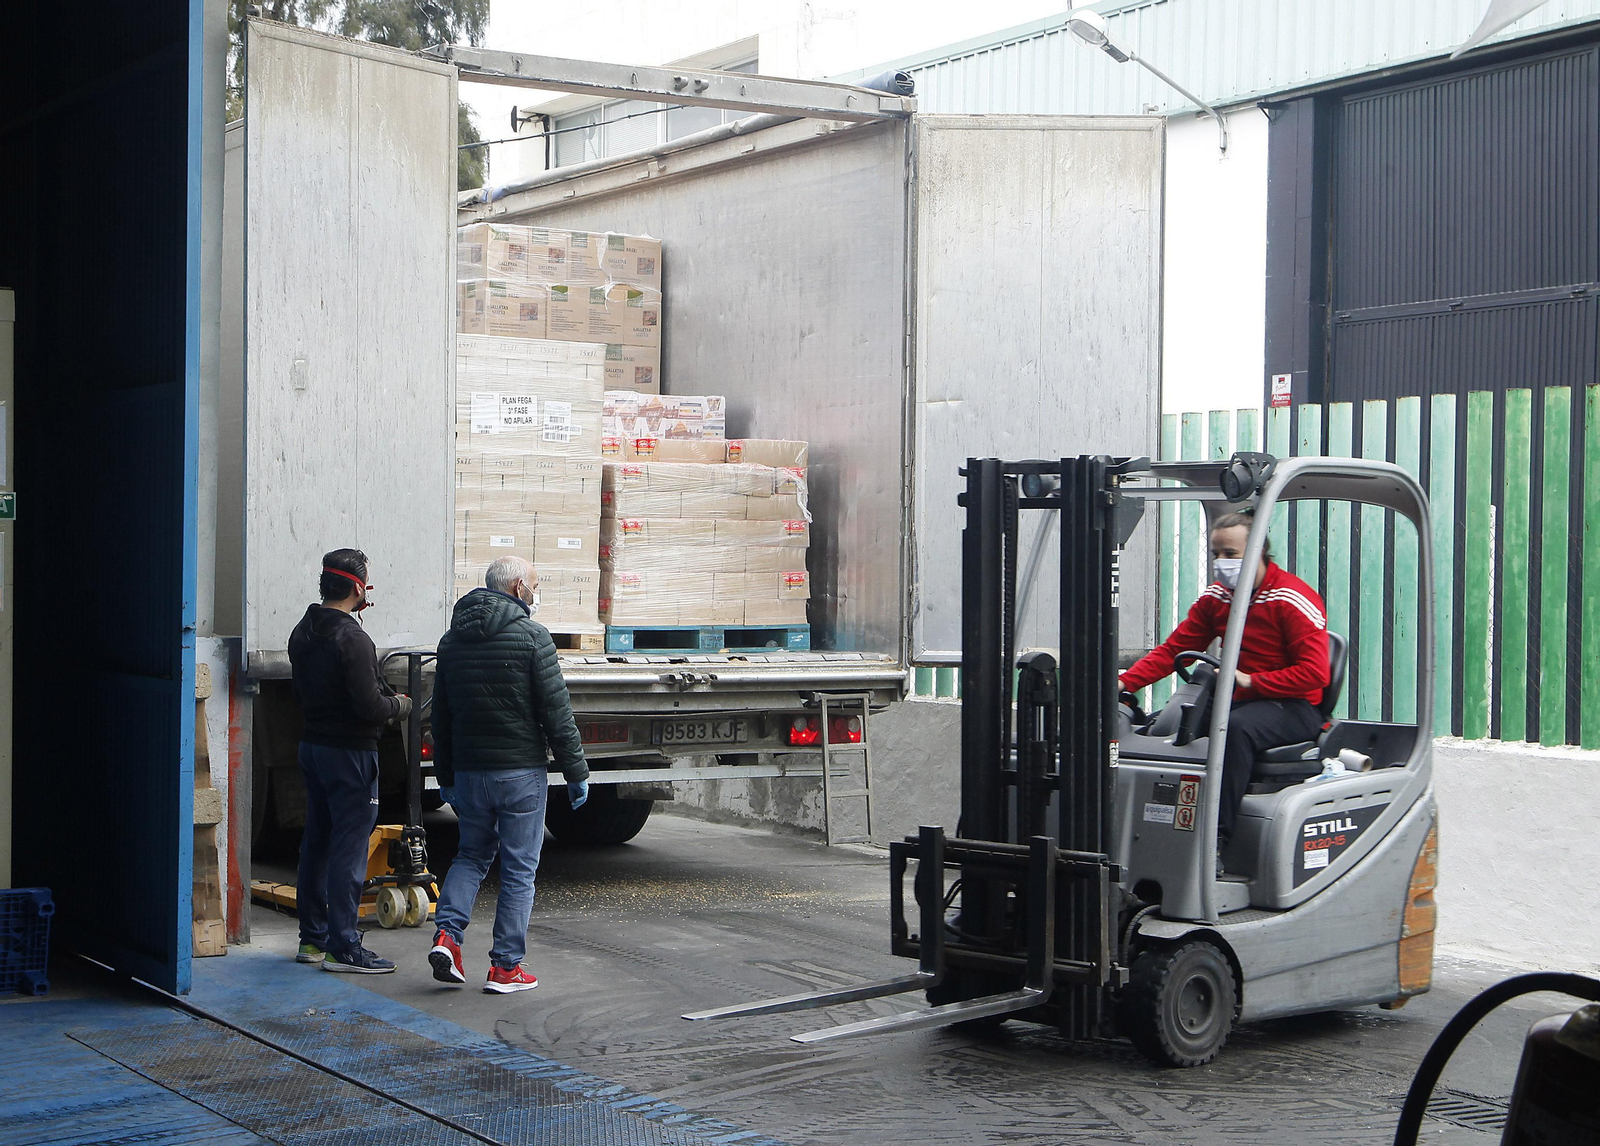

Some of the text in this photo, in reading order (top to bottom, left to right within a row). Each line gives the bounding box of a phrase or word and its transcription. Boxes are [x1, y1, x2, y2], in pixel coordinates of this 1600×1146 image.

[1111, 542, 1120, 608] STILL
[664, 720, 745, 741] 9583 KJF
[1303, 817, 1358, 838] STILL
[1303, 835, 1346, 851] RX20-15
